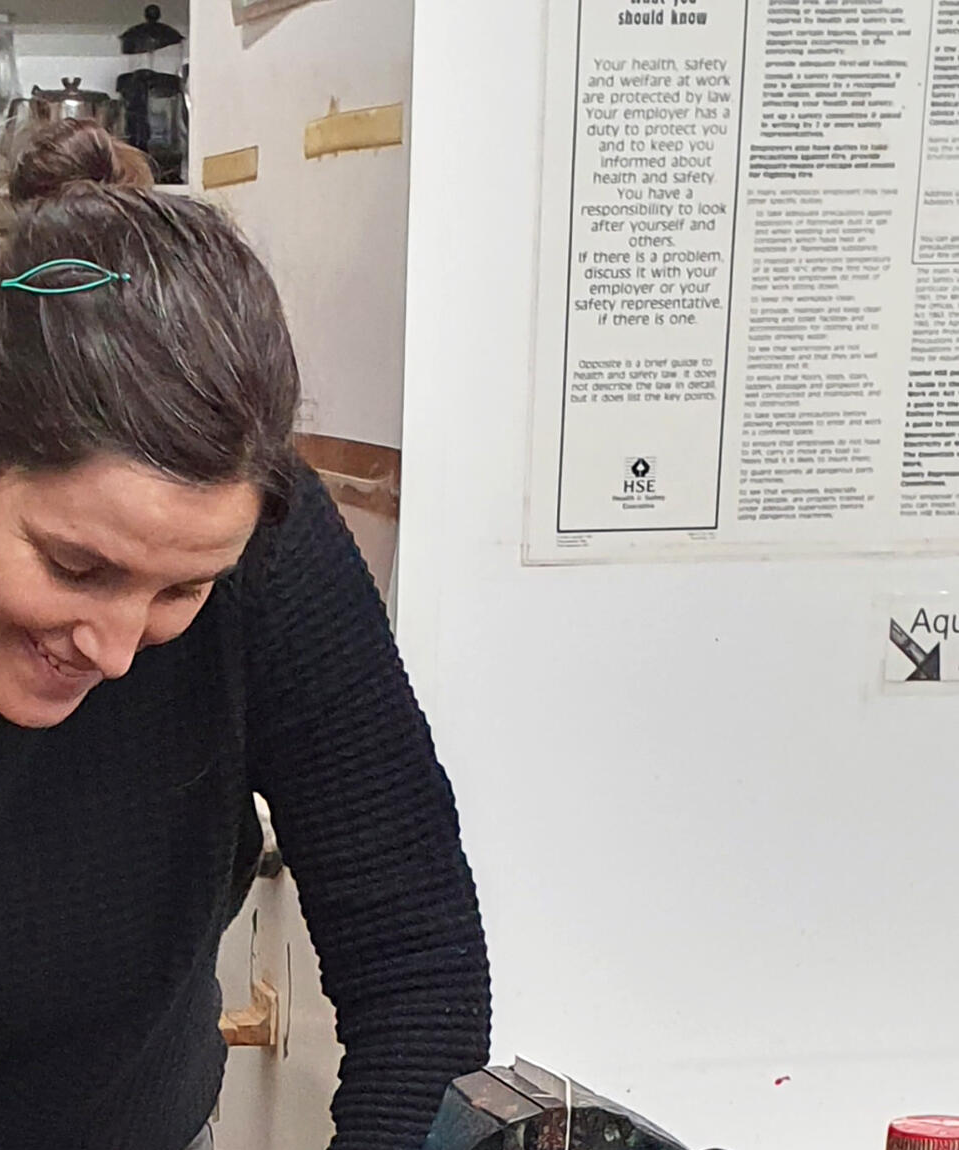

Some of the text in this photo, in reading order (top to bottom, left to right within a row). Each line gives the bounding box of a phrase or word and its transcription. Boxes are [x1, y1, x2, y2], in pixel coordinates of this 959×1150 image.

[618, 10, 707, 25] should know
[594, 59, 627, 70] Your
[684, 58, 727, 72] safety
[588, 75, 731, 86] and welfare at work
[582, 93, 605, 102] are
[610, 91, 680, 104] protected
[685, 90, 703, 104] by
[586, 107, 730, 121] Your employer has a
[587, 123, 727, 138] duty to protect you
[598, 139, 714, 153] and to keep you
[601, 155, 712, 166] informed about
[593, 172, 636, 183] health
[641, 172, 667, 182] and
[617, 187, 693, 198] You have a
[581, 203, 727, 217] responsibility to look
[591, 219, 715, 232] after yourself and
[578, 252, 588, 263] If
[593, 251, 631, 262] there
[636, 251, 645, 262] is
[650, 253, 657, 262] a
[584, 266, 718, 280] discuss it with your
[589, 283, 711, 296] employer or your
[575, 299, 616, 312] safety
[598, 313, 607, 324] if
[613, 313, 649, 324] there
[655, 313, 664, 324] is
[624, 480, 655, 493] HSE
[910, 607, 959, 641] Aqu
